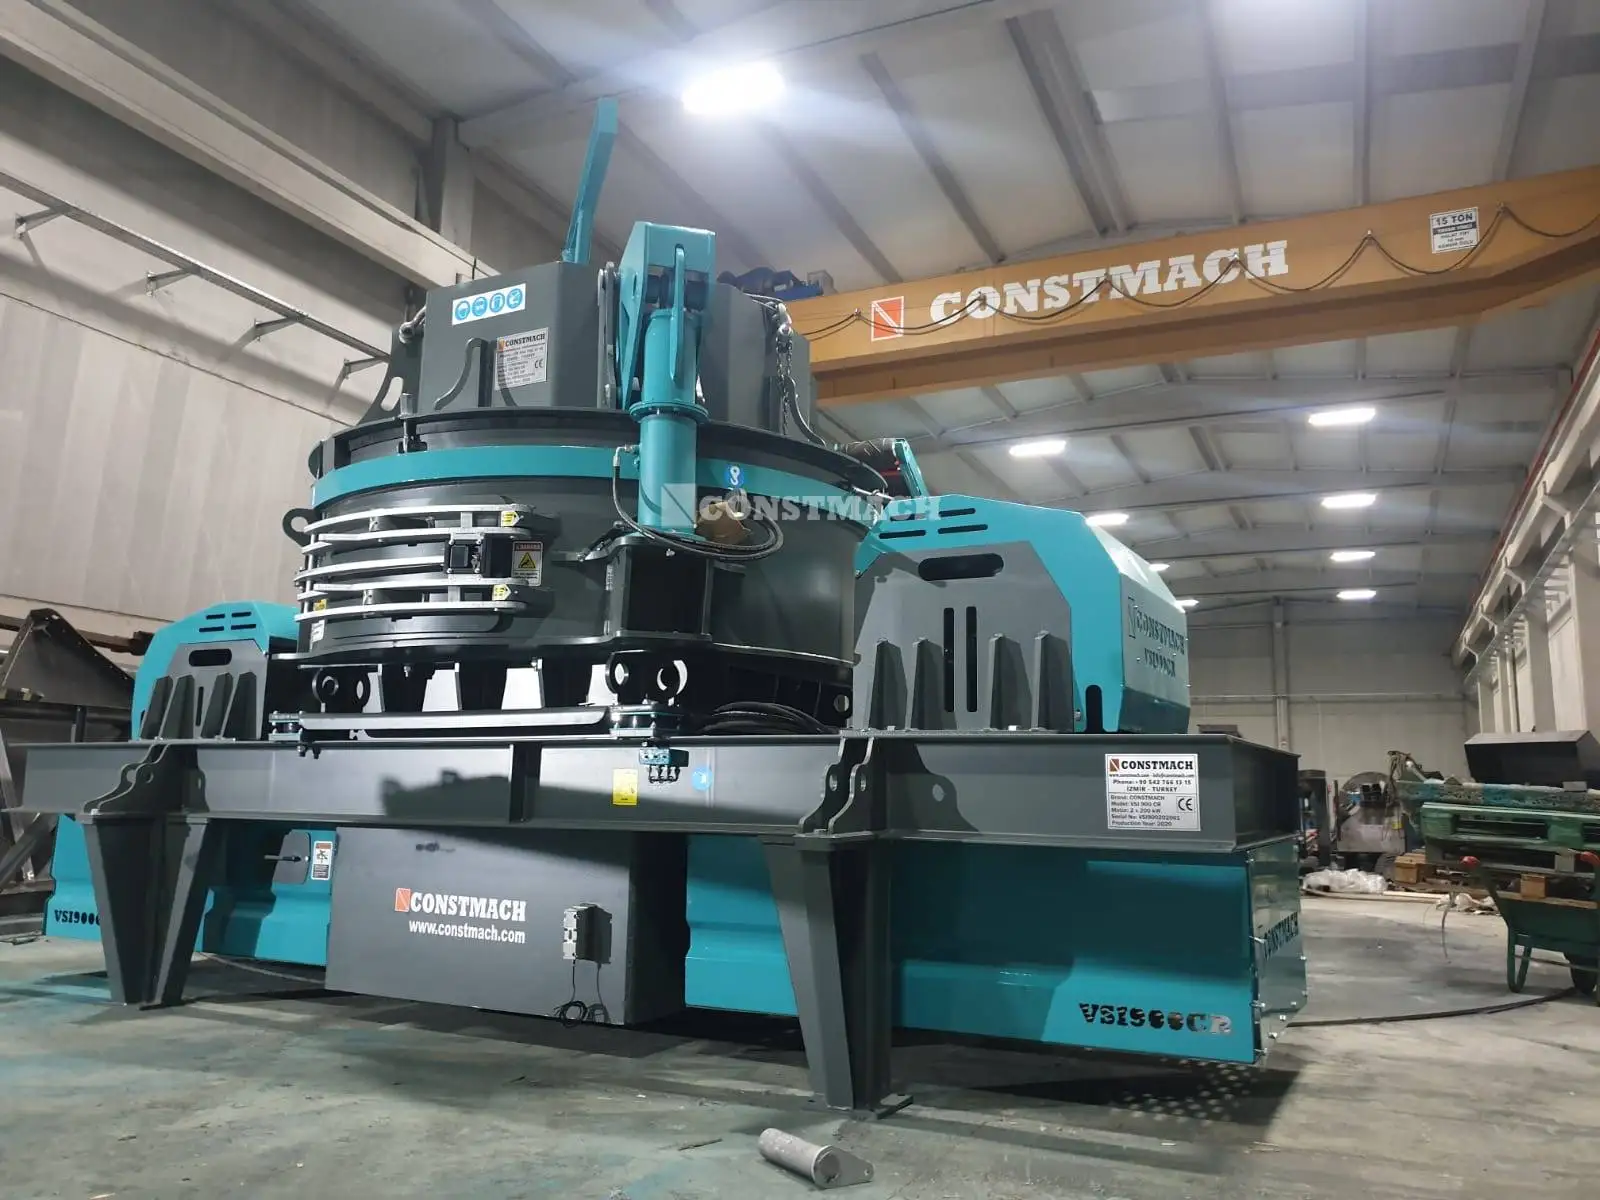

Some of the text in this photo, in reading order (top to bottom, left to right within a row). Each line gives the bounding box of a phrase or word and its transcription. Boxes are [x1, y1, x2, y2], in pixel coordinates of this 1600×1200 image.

[1436, 213, 1473, 226] 15 TON
[930, 240, 1289, 326] CONSTMACH
[505, 333, 546, 347] CONSTMACH
[1121, 760, 1194, 770] CONSTMACH
[410, 891, 527, 922] CONSTMACH
[408, 920, 526, 944] www.constmach.com
[1079, 1003, 1232, 1034] VSI900CR
